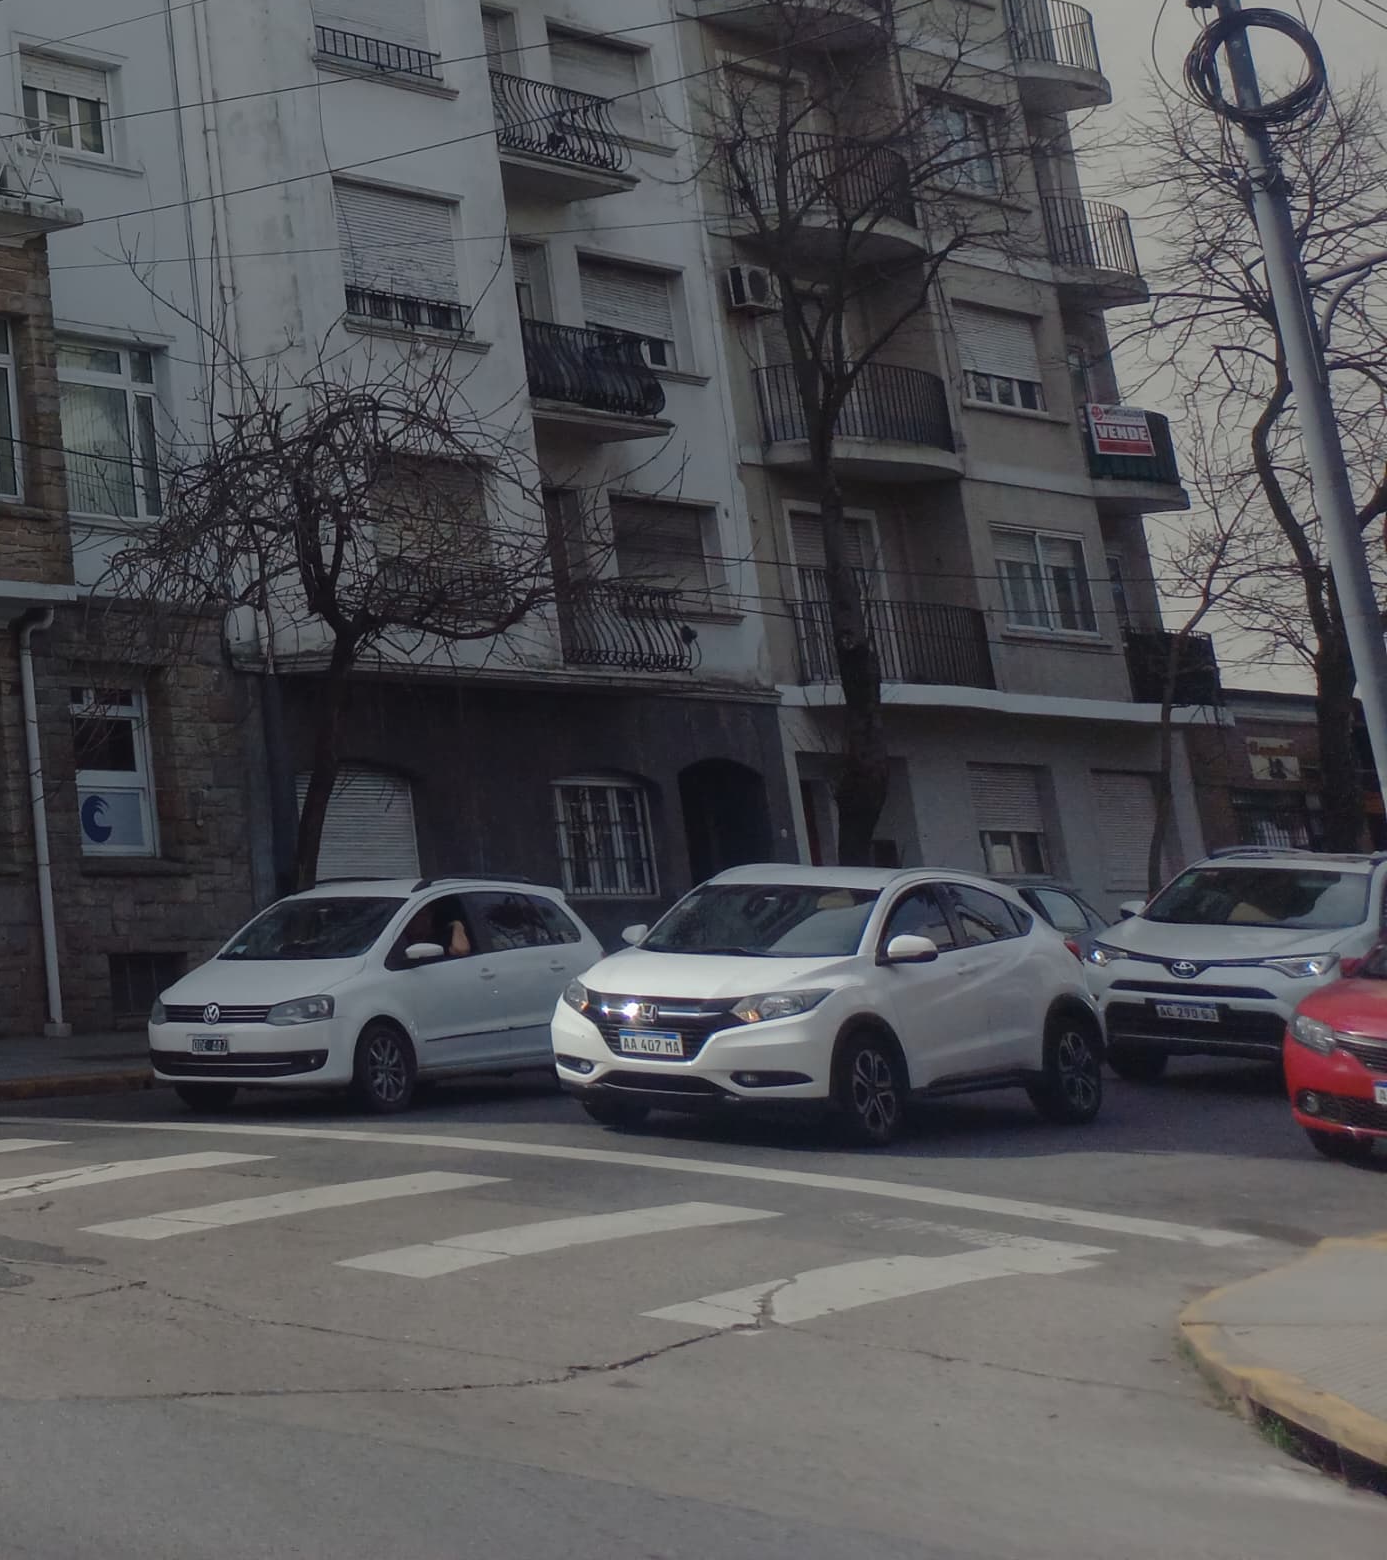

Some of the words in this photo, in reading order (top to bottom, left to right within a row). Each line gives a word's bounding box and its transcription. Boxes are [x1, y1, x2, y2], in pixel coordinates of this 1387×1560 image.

[1096, 424, 1149, 441] VENDE
[624, 1037, 637, 1050] AA
[641, 1039, 661, 1052] 407
[665, 1040, 680, 1053] MA
